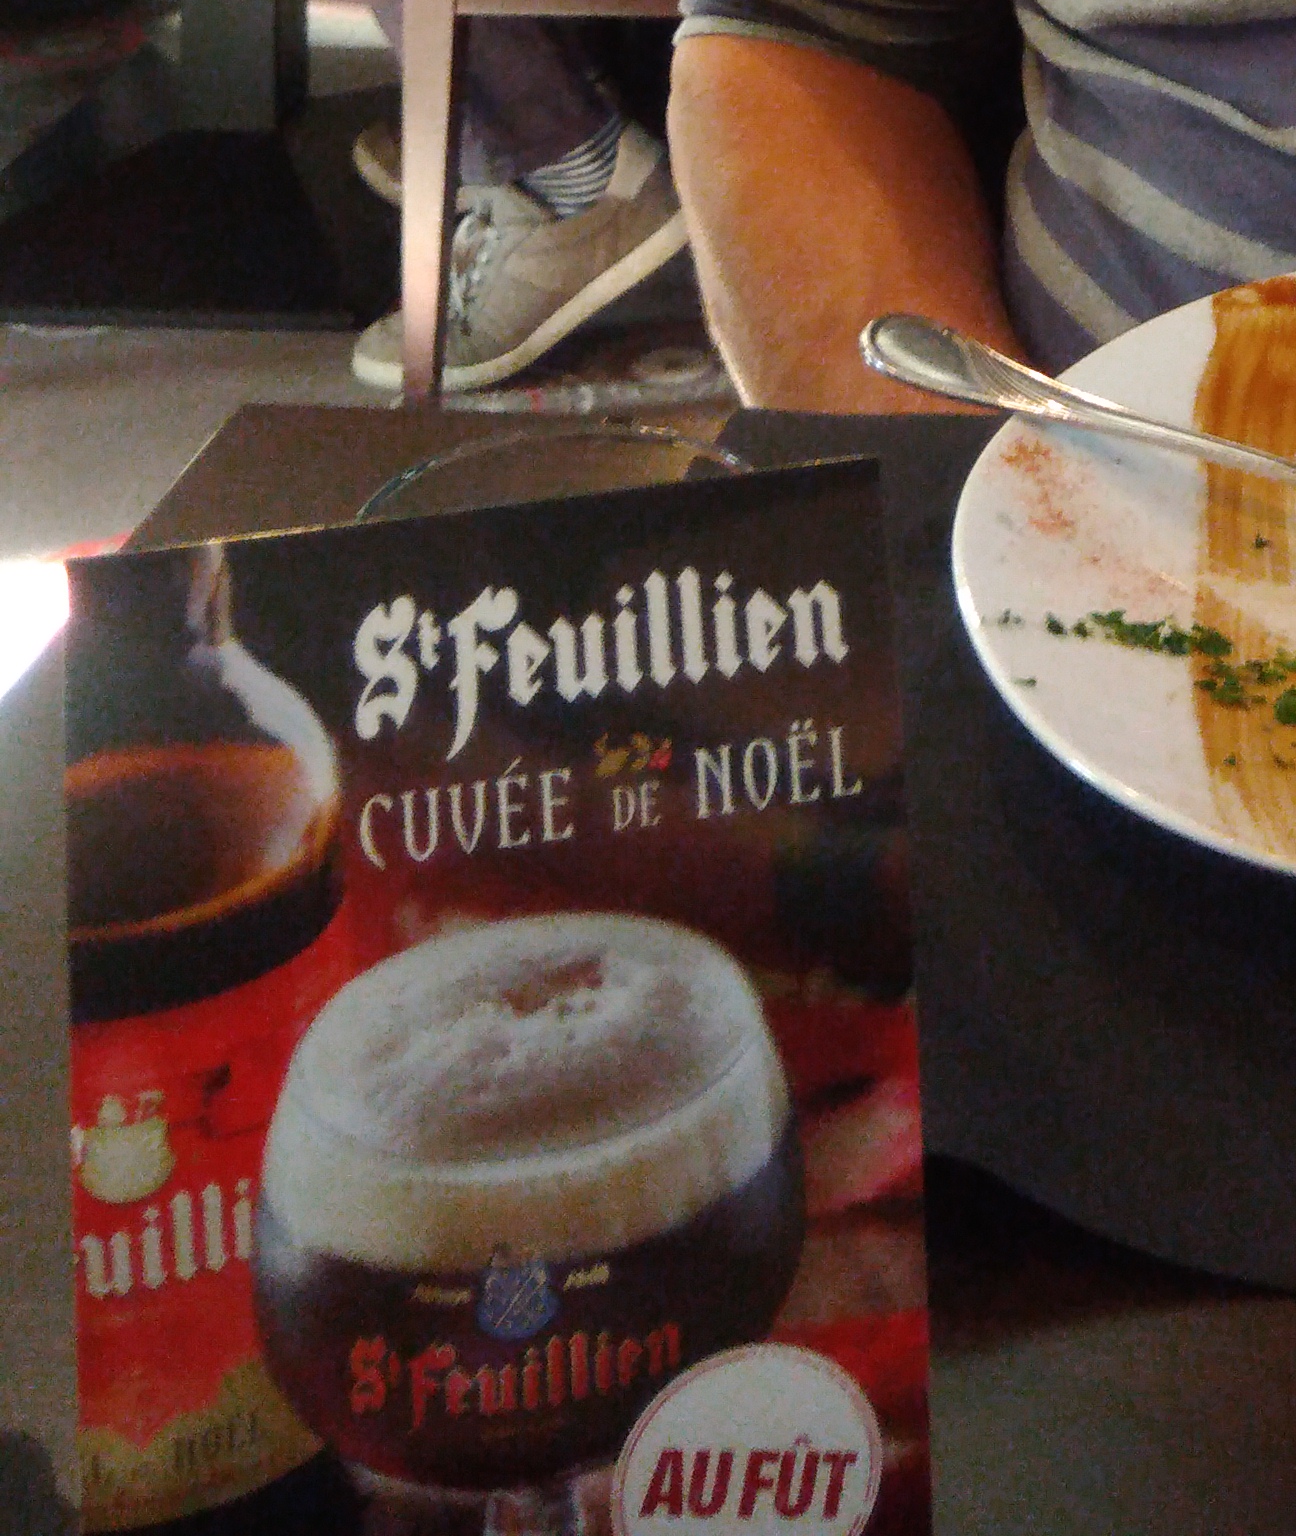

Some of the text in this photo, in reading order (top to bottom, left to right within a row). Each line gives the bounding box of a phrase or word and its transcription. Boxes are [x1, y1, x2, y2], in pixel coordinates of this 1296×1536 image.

[446, 565, 850, 762] Feuillien
[358, 718, 864, 872] CUVÉE DE NOËL
[80, 1178, 253, 1296] uilli
[407, 1321, 681, 1433] Feuillien
[638, 1433, 859, 1520] AU FÛT
